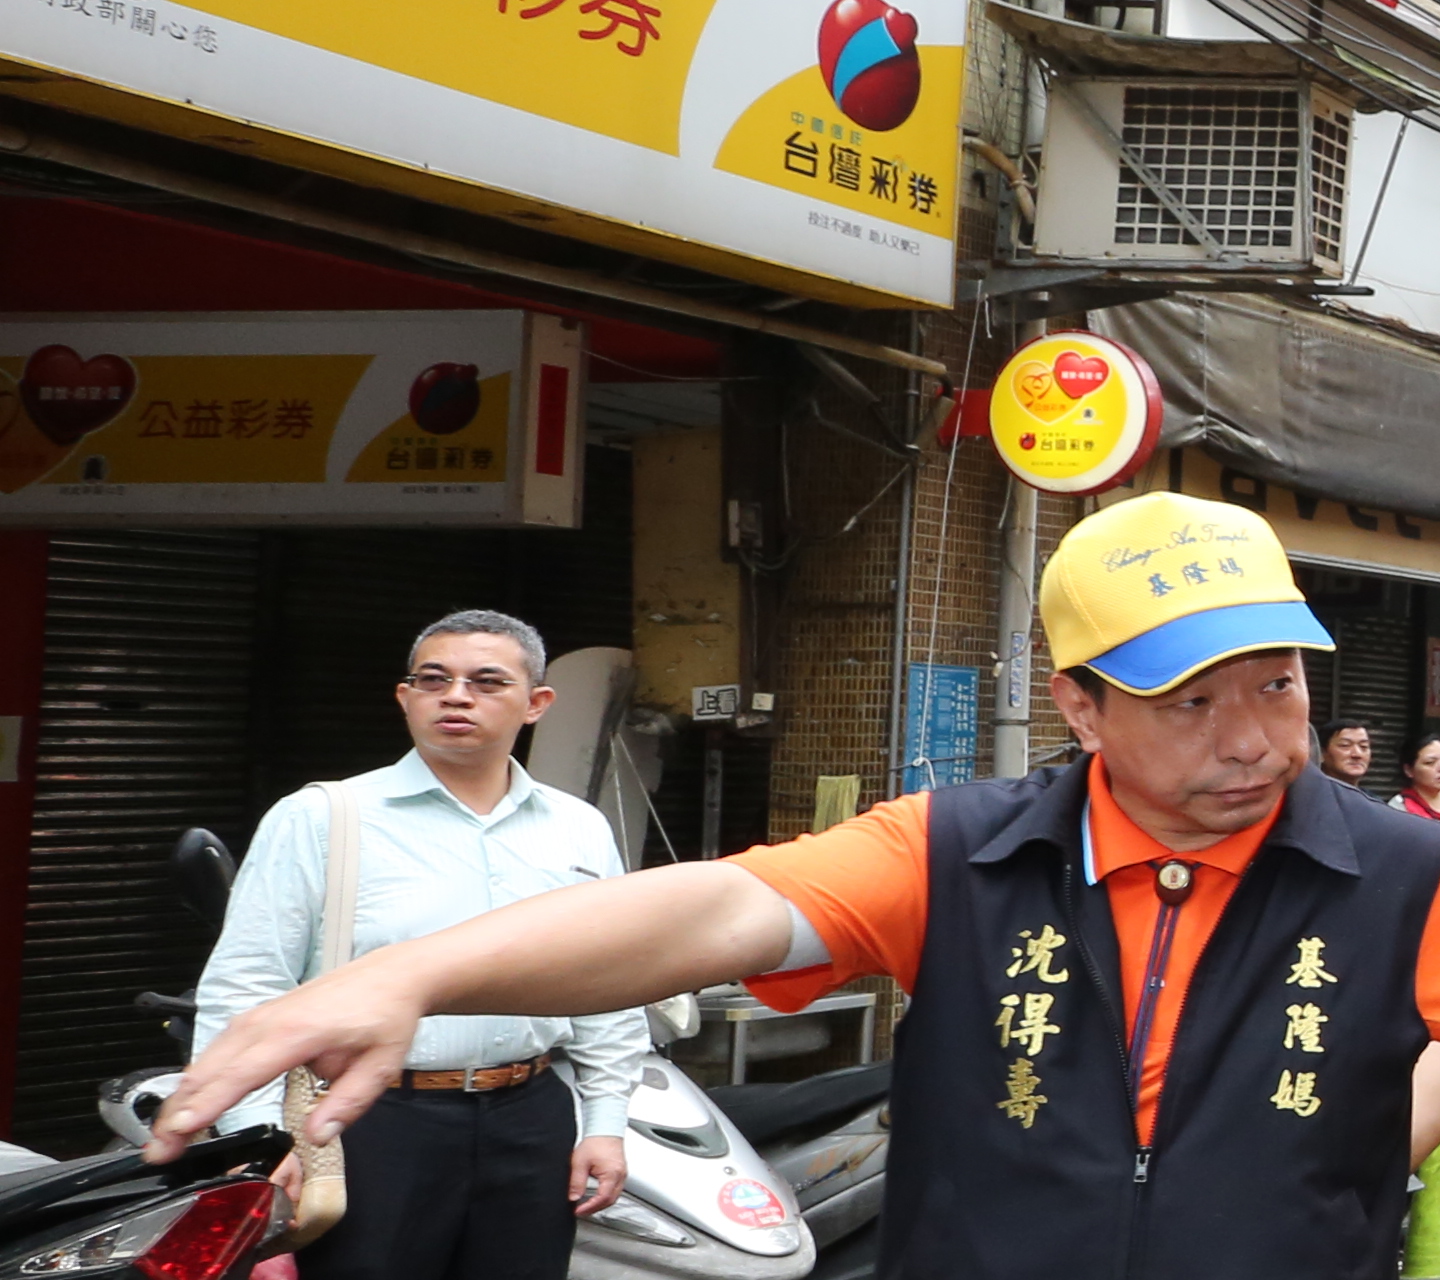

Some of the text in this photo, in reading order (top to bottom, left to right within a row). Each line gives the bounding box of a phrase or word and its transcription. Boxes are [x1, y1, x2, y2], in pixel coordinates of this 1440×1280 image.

[784, 130, 939, 215] 台灣彩券
[137, 399, 315, 441] 公益彩券
[1147, 557, 1245, 598] 基隆媽
[994, 924, 1070, 1130] 沈得壽
[1269, 936, 1339, 1118] 基隆媽
